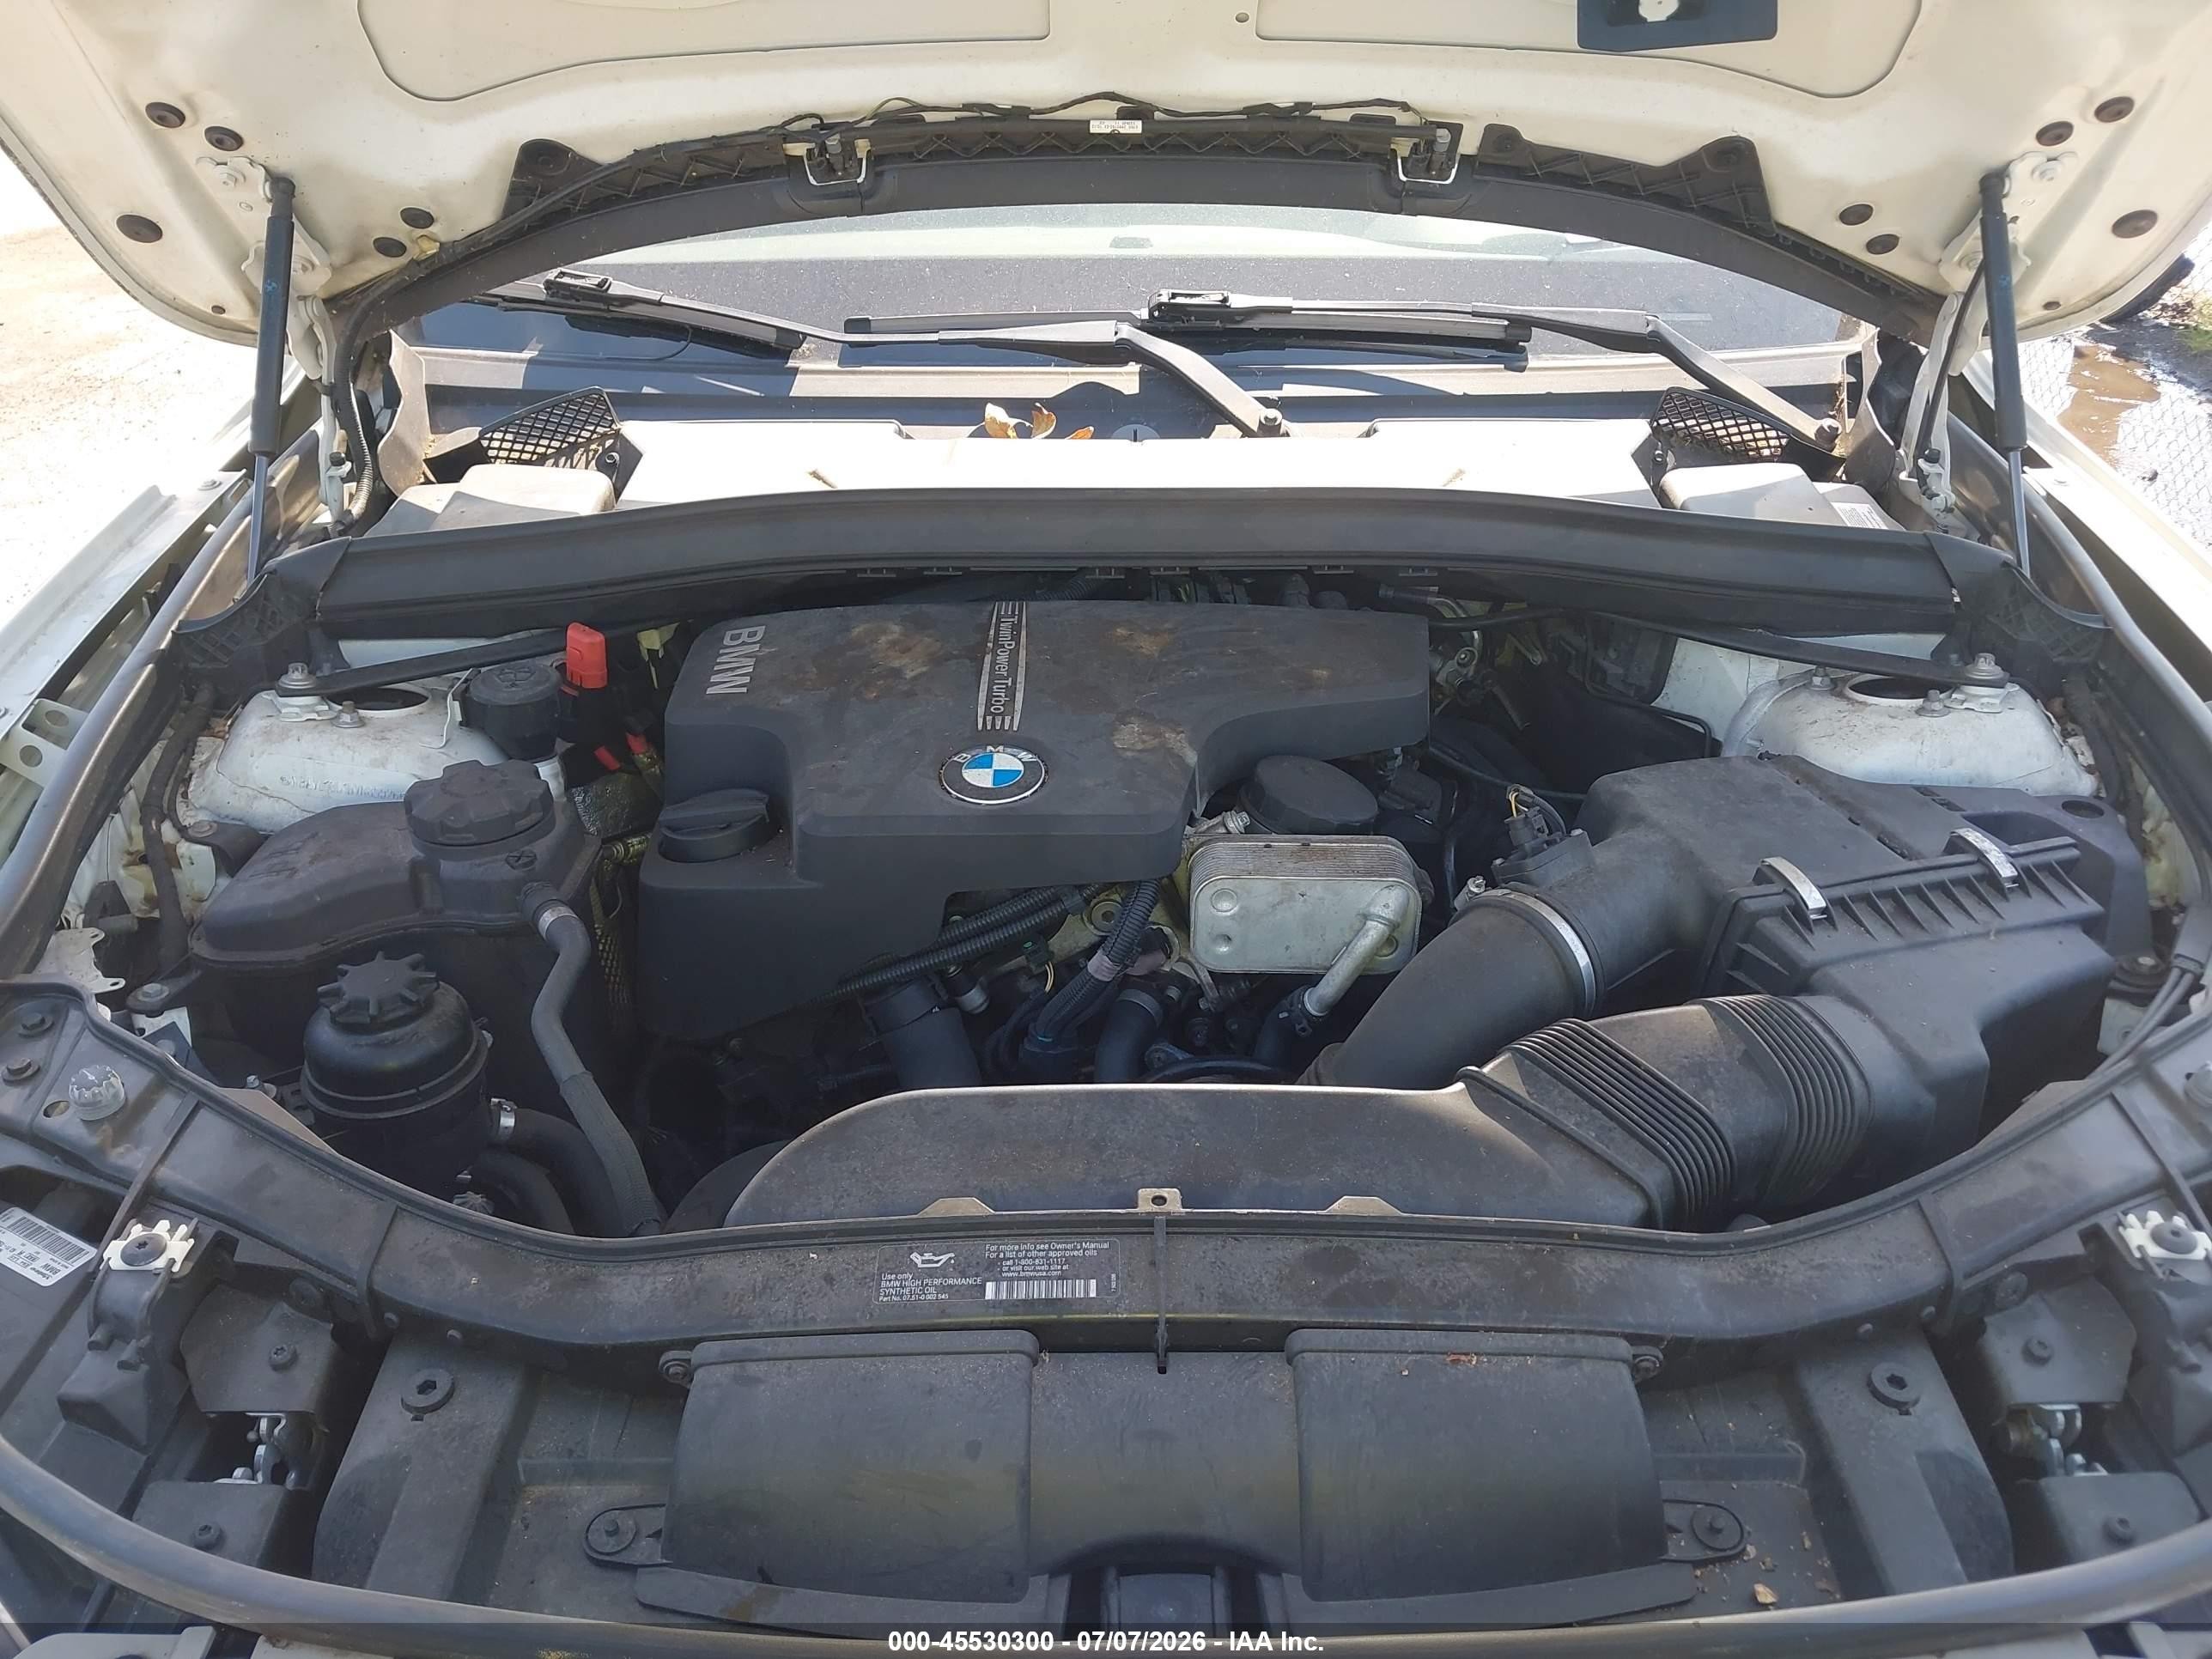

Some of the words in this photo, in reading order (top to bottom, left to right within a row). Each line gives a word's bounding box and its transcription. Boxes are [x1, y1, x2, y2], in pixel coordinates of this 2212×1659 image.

[994, 616, 1018, 677] TwinPower
[706, 625, 766, 694] BMW
[990, 677, 1012, 713] Turbo
[953, 745, 1037, 763] BMW
[1048, 1249, 1083, 1258] approved
[40, 1262, 61, 1274] BMW
[897, 1273, 914, 1281] only
[924, 1277, 982, 1286] PERFORMANCE
[879, 1287, 922, 1296] SYNTHETIC
